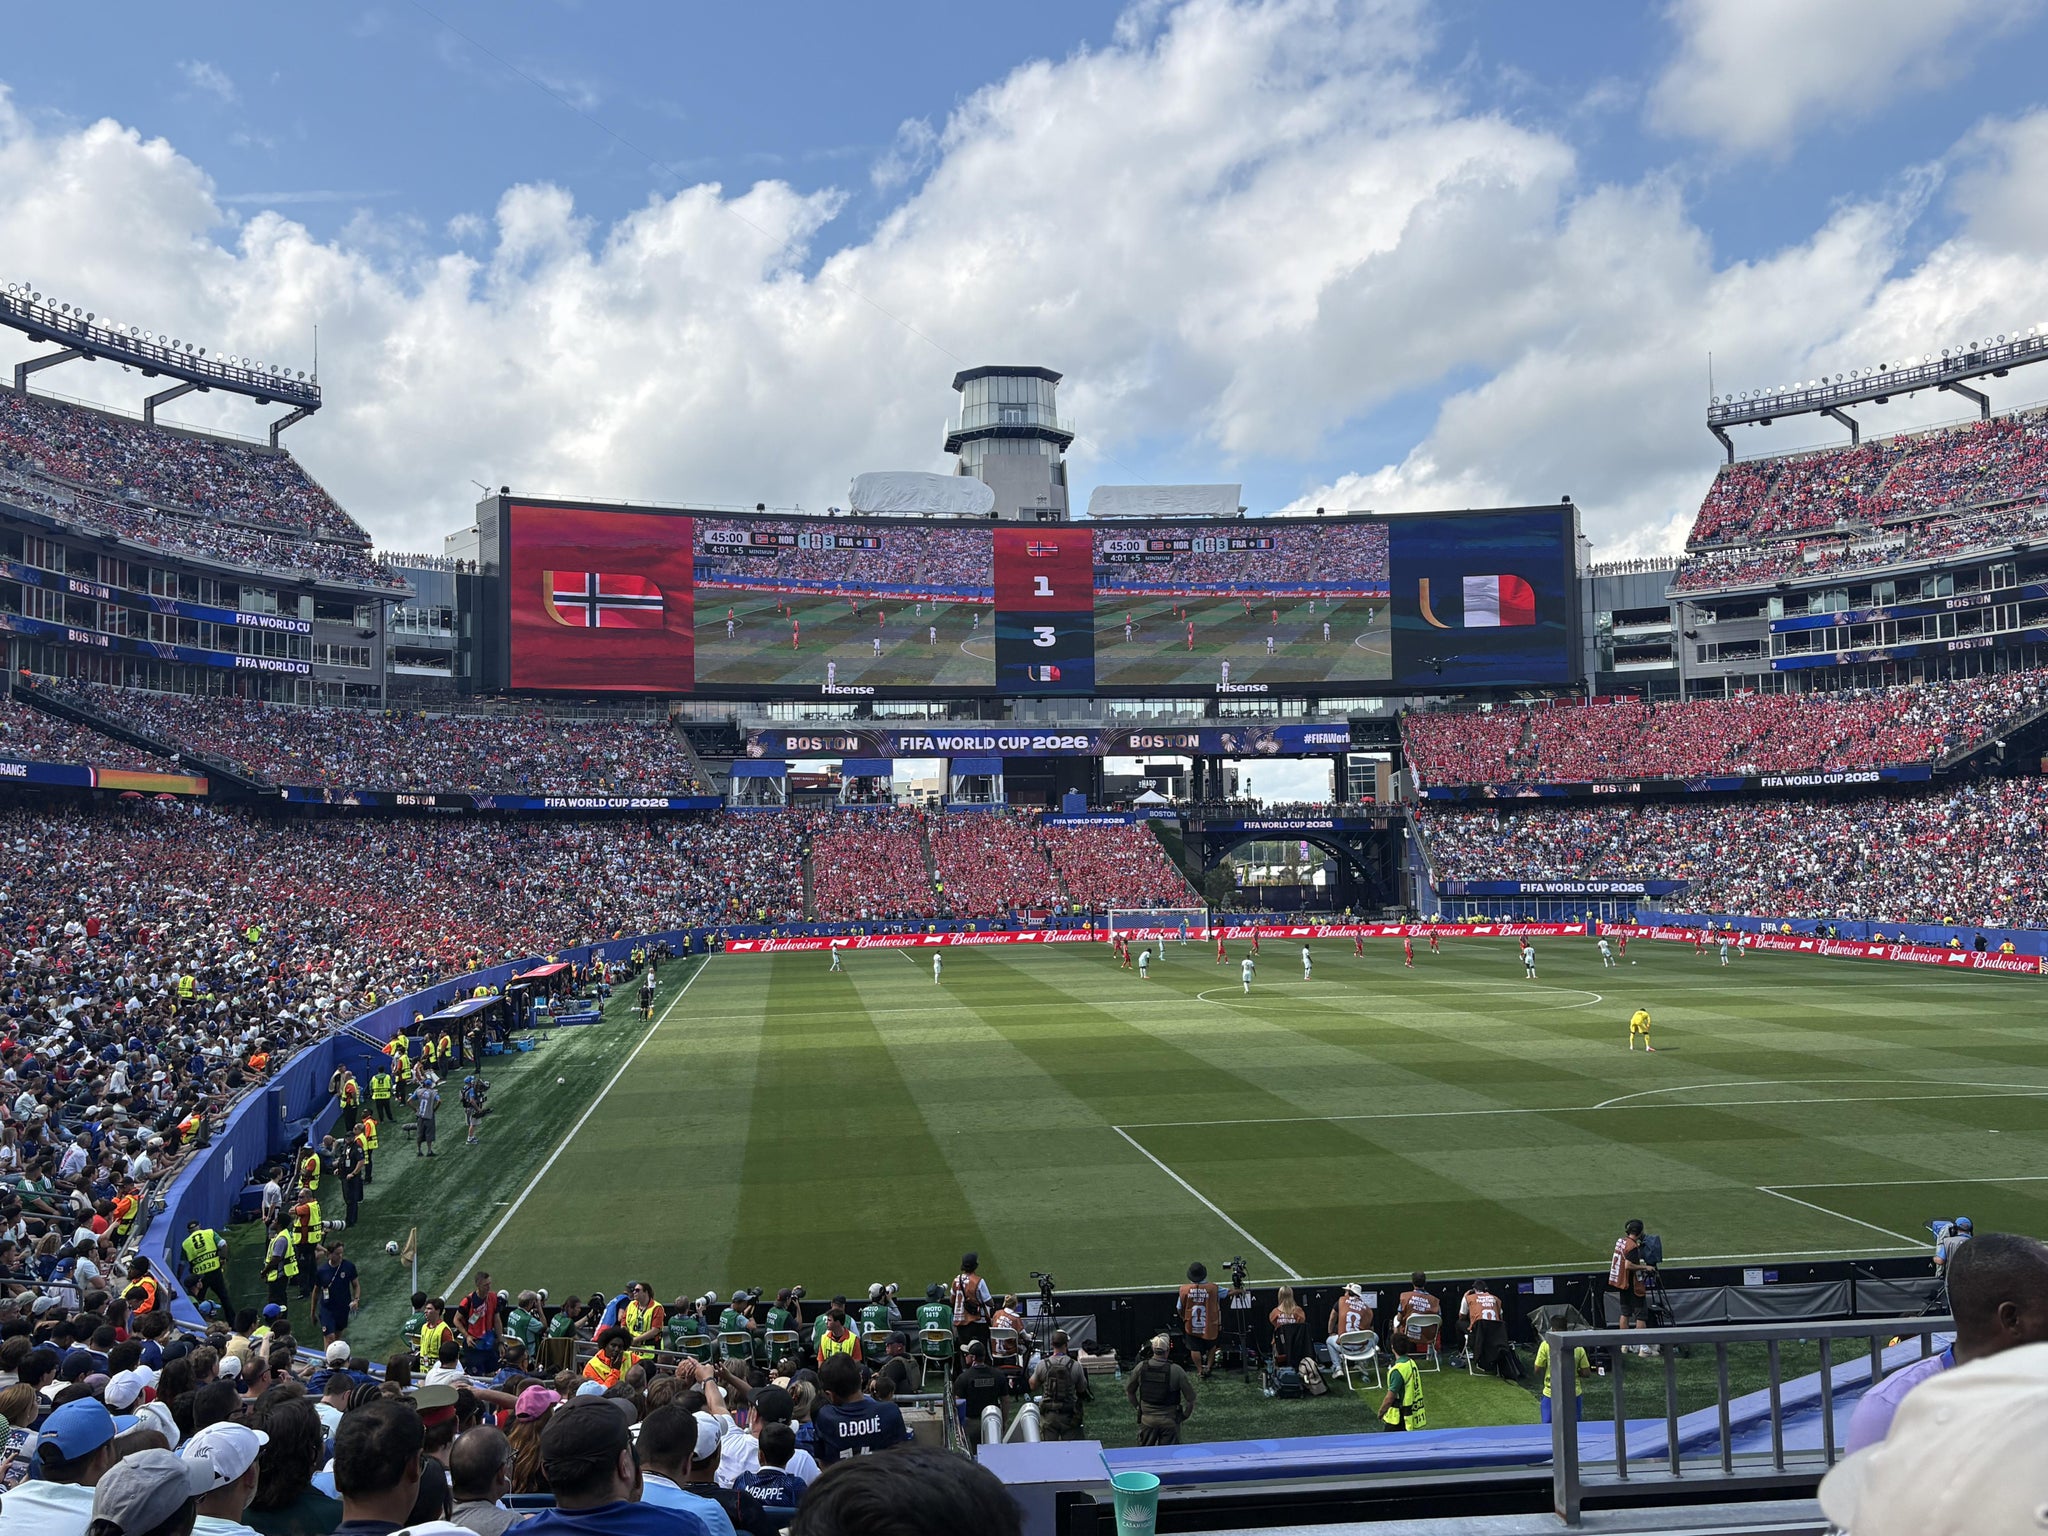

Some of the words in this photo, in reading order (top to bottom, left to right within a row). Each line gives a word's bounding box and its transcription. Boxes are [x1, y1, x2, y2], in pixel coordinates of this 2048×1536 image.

[711, 532, 743, 543] 45:00
[778, 536, 795, 545] NOR
[801, 537, 807, 546] 1
[825, 537, 832, 547] 3
[838, 538, 854, 547] FRA
[712, 546, 729, 554] 4:01
[733, 547, 744, 555] +5
[1110, 541, 1140, 551] 45:00
[1173, 541, 1189, 550] NOR
[1195, 541, 1200, 550] 1
[1218, 541, 1226, 550] 3
[1232, 540, 1247, 549] FRA
[1110, 554, 1127, 562] 4:01
[70, 580, 109, 599] BOSTON
[1033, 575, 1055, 597] 1
[1946, 594, 1991, 609] BOSTON
[236, 613, 258, 626] FIFA
[259, 616, 296, 631] WORLD
[296, 622, 310, 633] CU
[68, 630, 109, 647] BOSTON
[1033, 626, 1057, 648] 3
[1948, 637, 1993, 651] BOSTON
[235, 656, 258, 669] FIFA
[259, 659, 295, 673] WORLD
[296, 663, 310, 674] CU
[821, 684, 875, 696] Hisense
[1216, 682, 1268, 693] Hisense
[786, 737, 858, 750] BOSTON
[900, 737, 935, 750] FIFA
[936, 736, 996, 750] WORLD
[998, 736, 1031, 750] CUP
[1032, 735, 1089, 749] 2026
[1130, 734, 1200, 748] BOSTON
[0, 762, 27, 777] RANCE
[1761, 777, 1784, 787] FIFA
[1784, 775, 1822, 786] WORLD
[1823, 773, 1844, 784] CUP
[1844, 771, 1880, 783] 2026
[1592, 783, 1641, 794] BOSTON
[396, 794, 436, 806] BOSTON
[544, 797, 567, 808] FIFA
[568, 797, 607, 808] WORLD
[608, 797, 630, 808] CUP
[630, 798, 669, 808] 2026
[1149, 810, 1177, 818] BOSTON
[1243, 821, 1261, 829] FIFA
[1261, 821, 1289, 829] WORLD
[1289, 821, 1306, 829] CUP
[1520, 883, 1545, 893] FIFA
[1545, 883, 1585, 893] WORLD
[1586, 883, 1609, 893] CUP
[1610, 883, 1645, 893] 2026
[1496, 924, 1558, 936] Budweiser
[1650, 926, 1683, 941] Budweiser
[1760, 922, 1778, 932] FIFA
[757, 938, 823, 952] Budweiser
[853, 935, 918, 949] Budweiser
[948, 932, 1011, 946] Budweiser
[1753, 934, 1796, 950] Budweiser
[1816, 939, 1864, 957] Budweiser
[1887, 944, 1943, 963] Budweiser
[1970, 951, 2035, 971] Budweiser
[1409, 1300, 1431, 1309] PARTNER
[1411, 1295, 1429, 1303] MEDIA
[838, 1415, 881, 1438] D.DOUÉ
